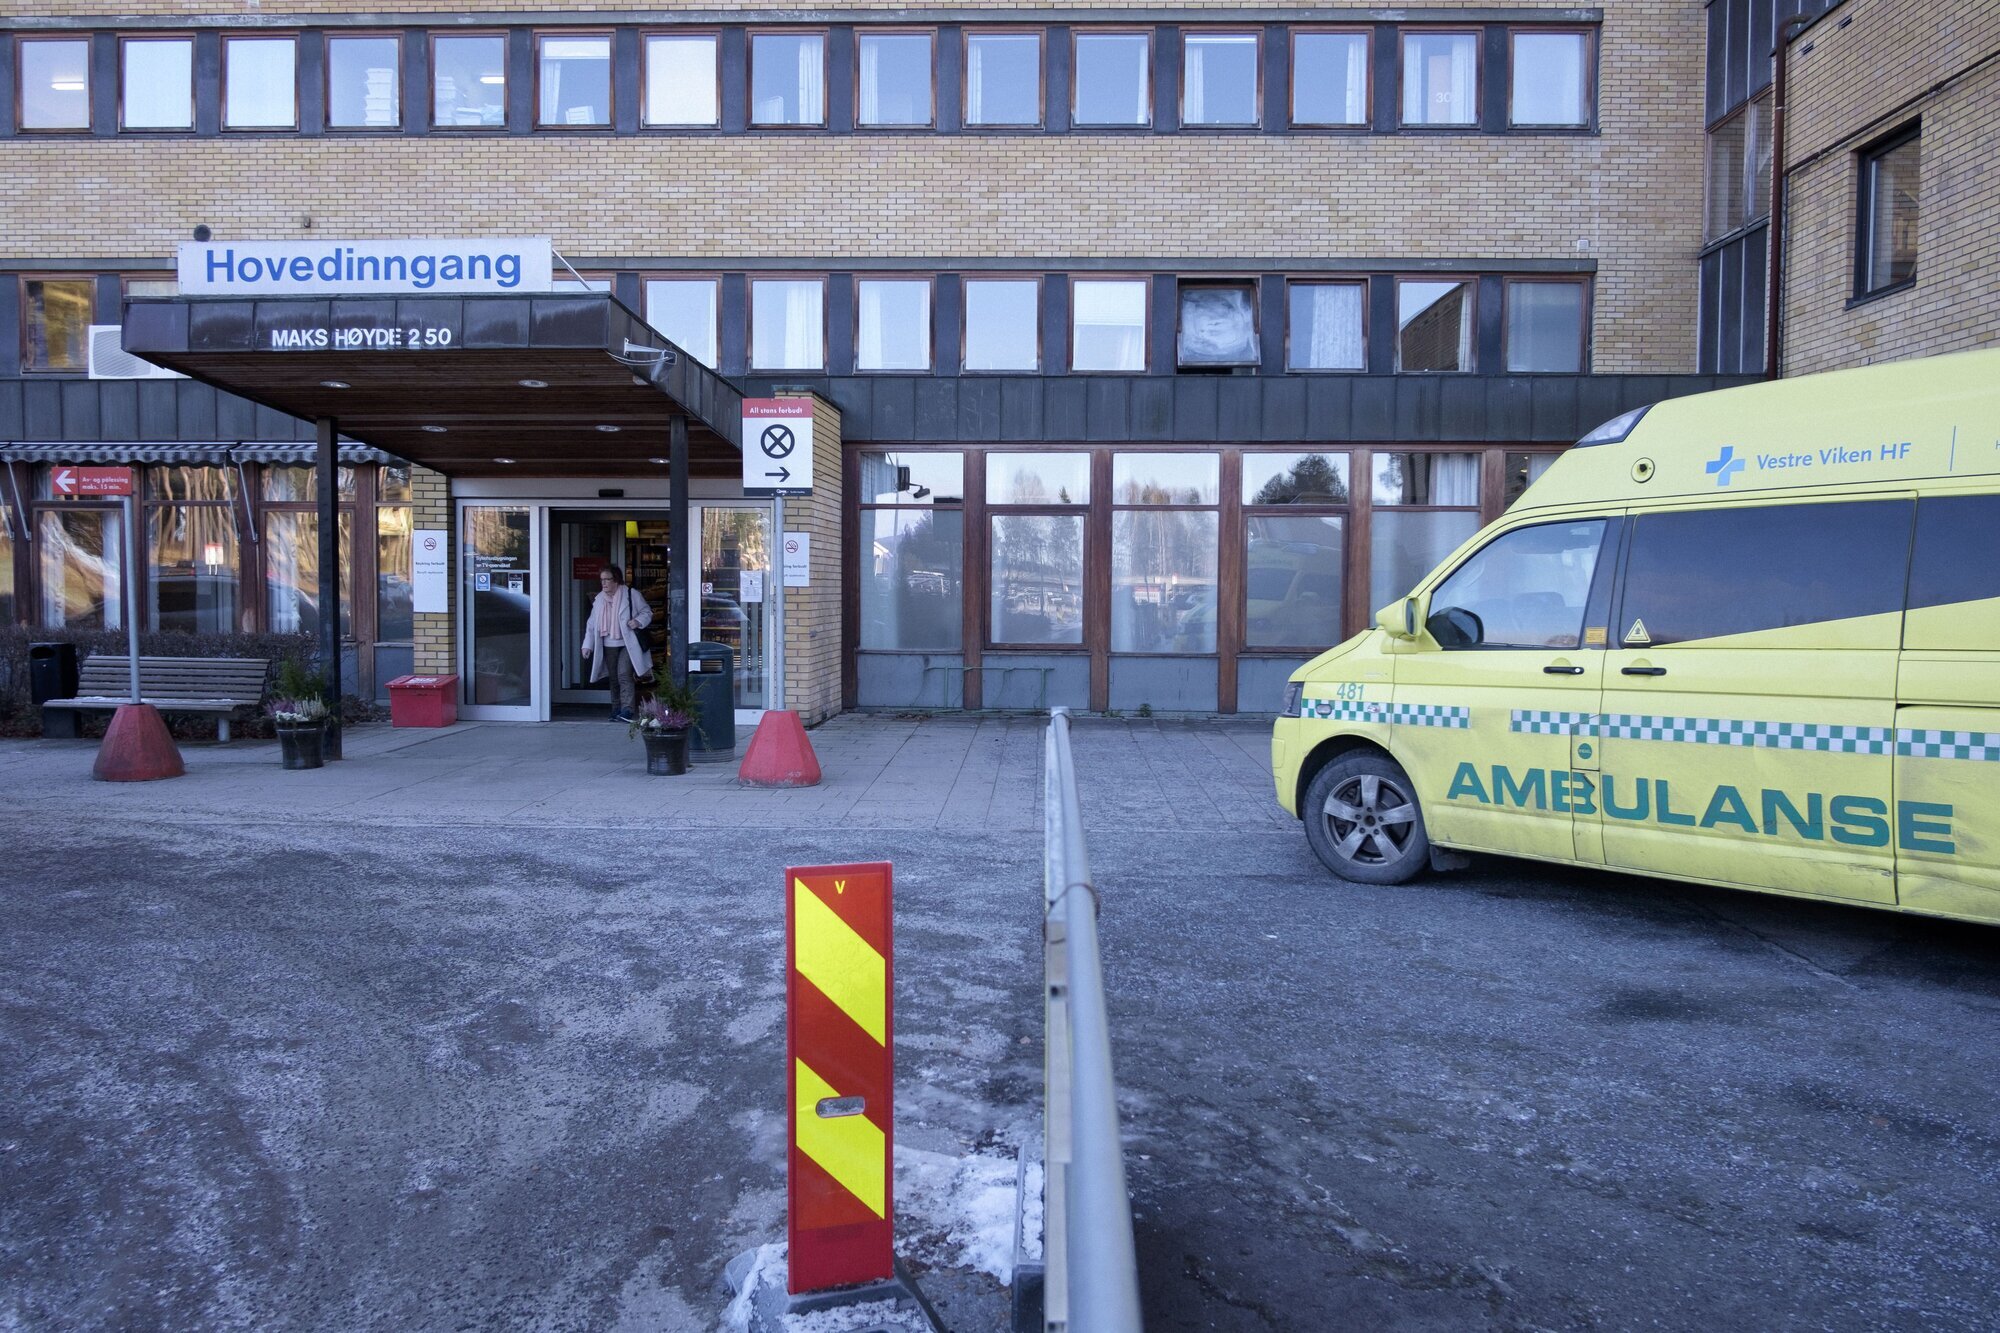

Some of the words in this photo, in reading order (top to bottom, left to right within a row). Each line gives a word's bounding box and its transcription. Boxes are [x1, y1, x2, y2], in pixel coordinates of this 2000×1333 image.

[206, 247, 521, 288] Hovedinngang
[272, 328, 328, 347] MAKS
[335, 328, 402, 346] HØYDE
[750, 406, 759, 414] All
[778, 406, 803, 414] forbudt
[1757, 453, 1812, 470] Vestre
[1819, 446, 1872, 465] Viken
[1880, 442, 1911, 460] HF
[1337, 682, 1364, 700] 481
[1446, 761, 1955, 855] AMBULANSE
[835, 880, 845, 894] V
